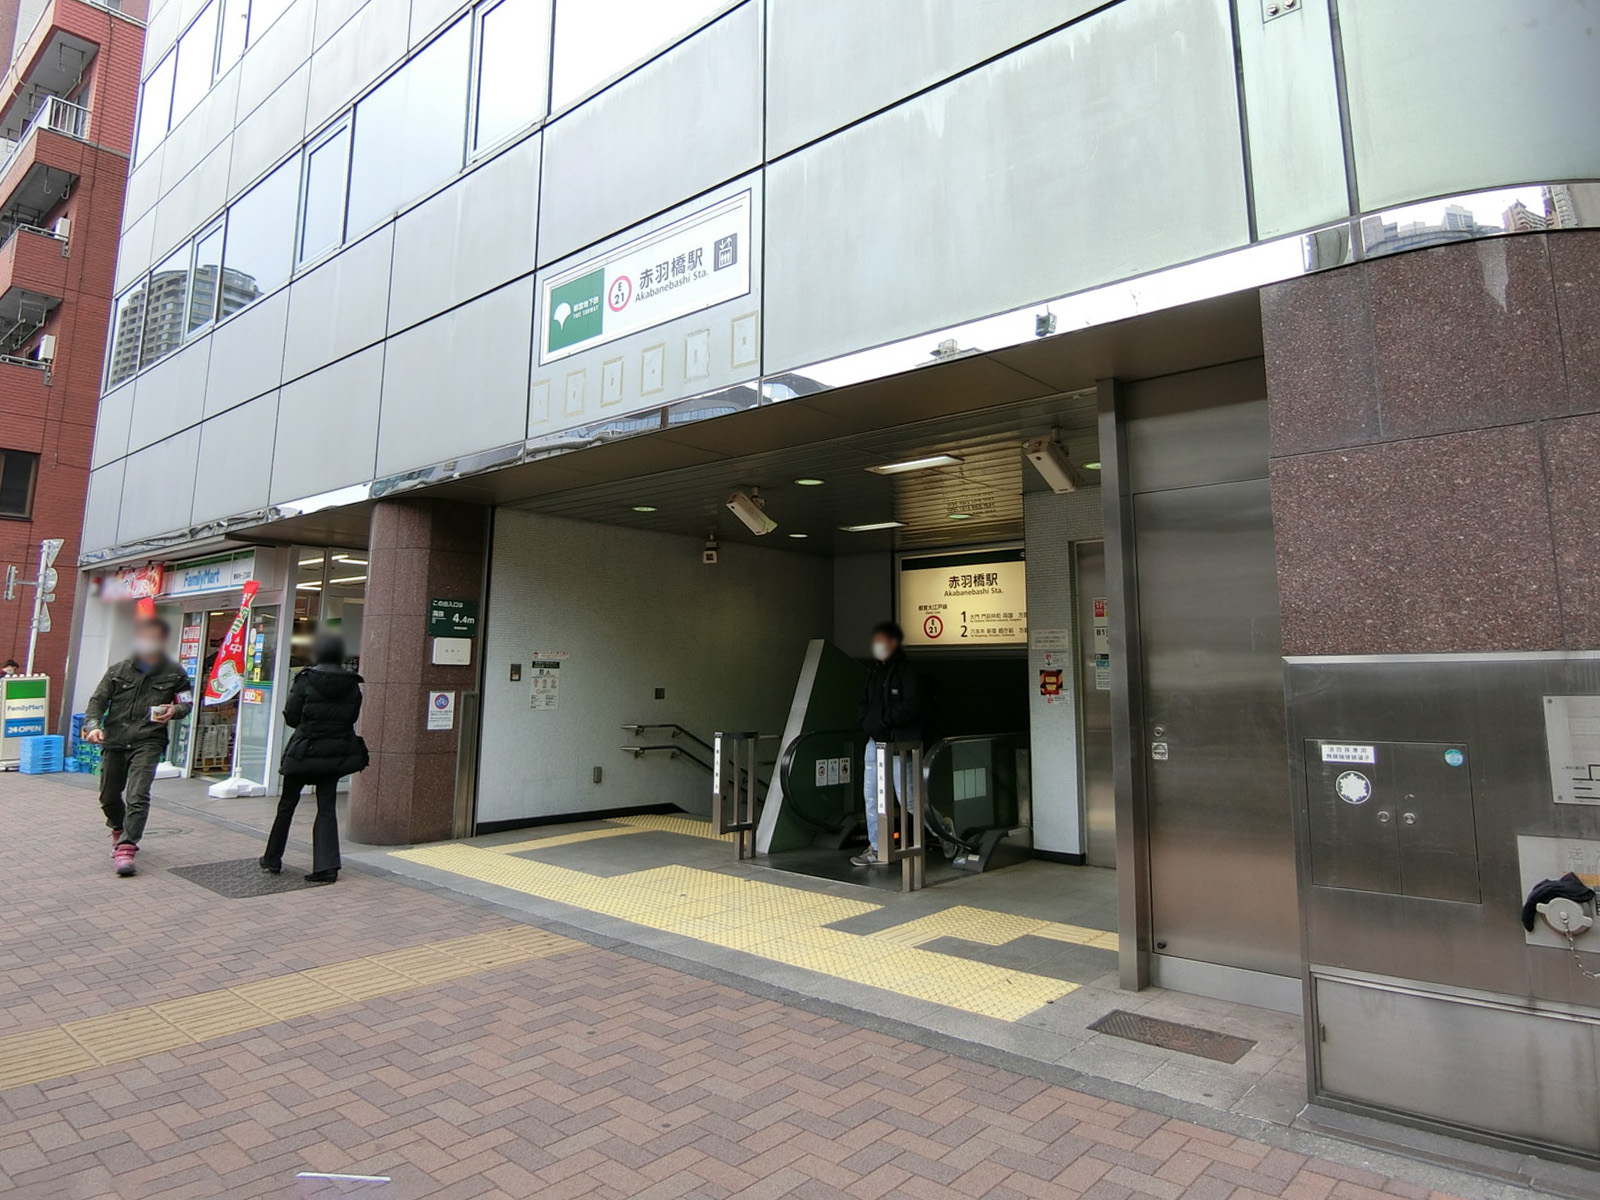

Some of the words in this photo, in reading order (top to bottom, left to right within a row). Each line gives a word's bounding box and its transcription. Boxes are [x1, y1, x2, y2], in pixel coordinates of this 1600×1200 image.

[639, 247, 703, 290] 赤羽橋駅
[635, 274, 690, 302] Akabanebashi
[693, 270, 709, 281] Sta.
[614, 292, 625, 305] 21
[183, 568, 220, 589] FamilyMart
[948, 572, 998, 588] 赤羽橋駅
[944, 588, 989, 597] Akabanebashi
[432, 600, 464, 608] この出入口は
[452, 613, 475, 624] 4.4m
[961, 611, 967, 623] 1
[960, 625, 968, 638] 2
[7, 704, 44, 712] FamilyMart
[19, 725, 42, 733] OPEN
